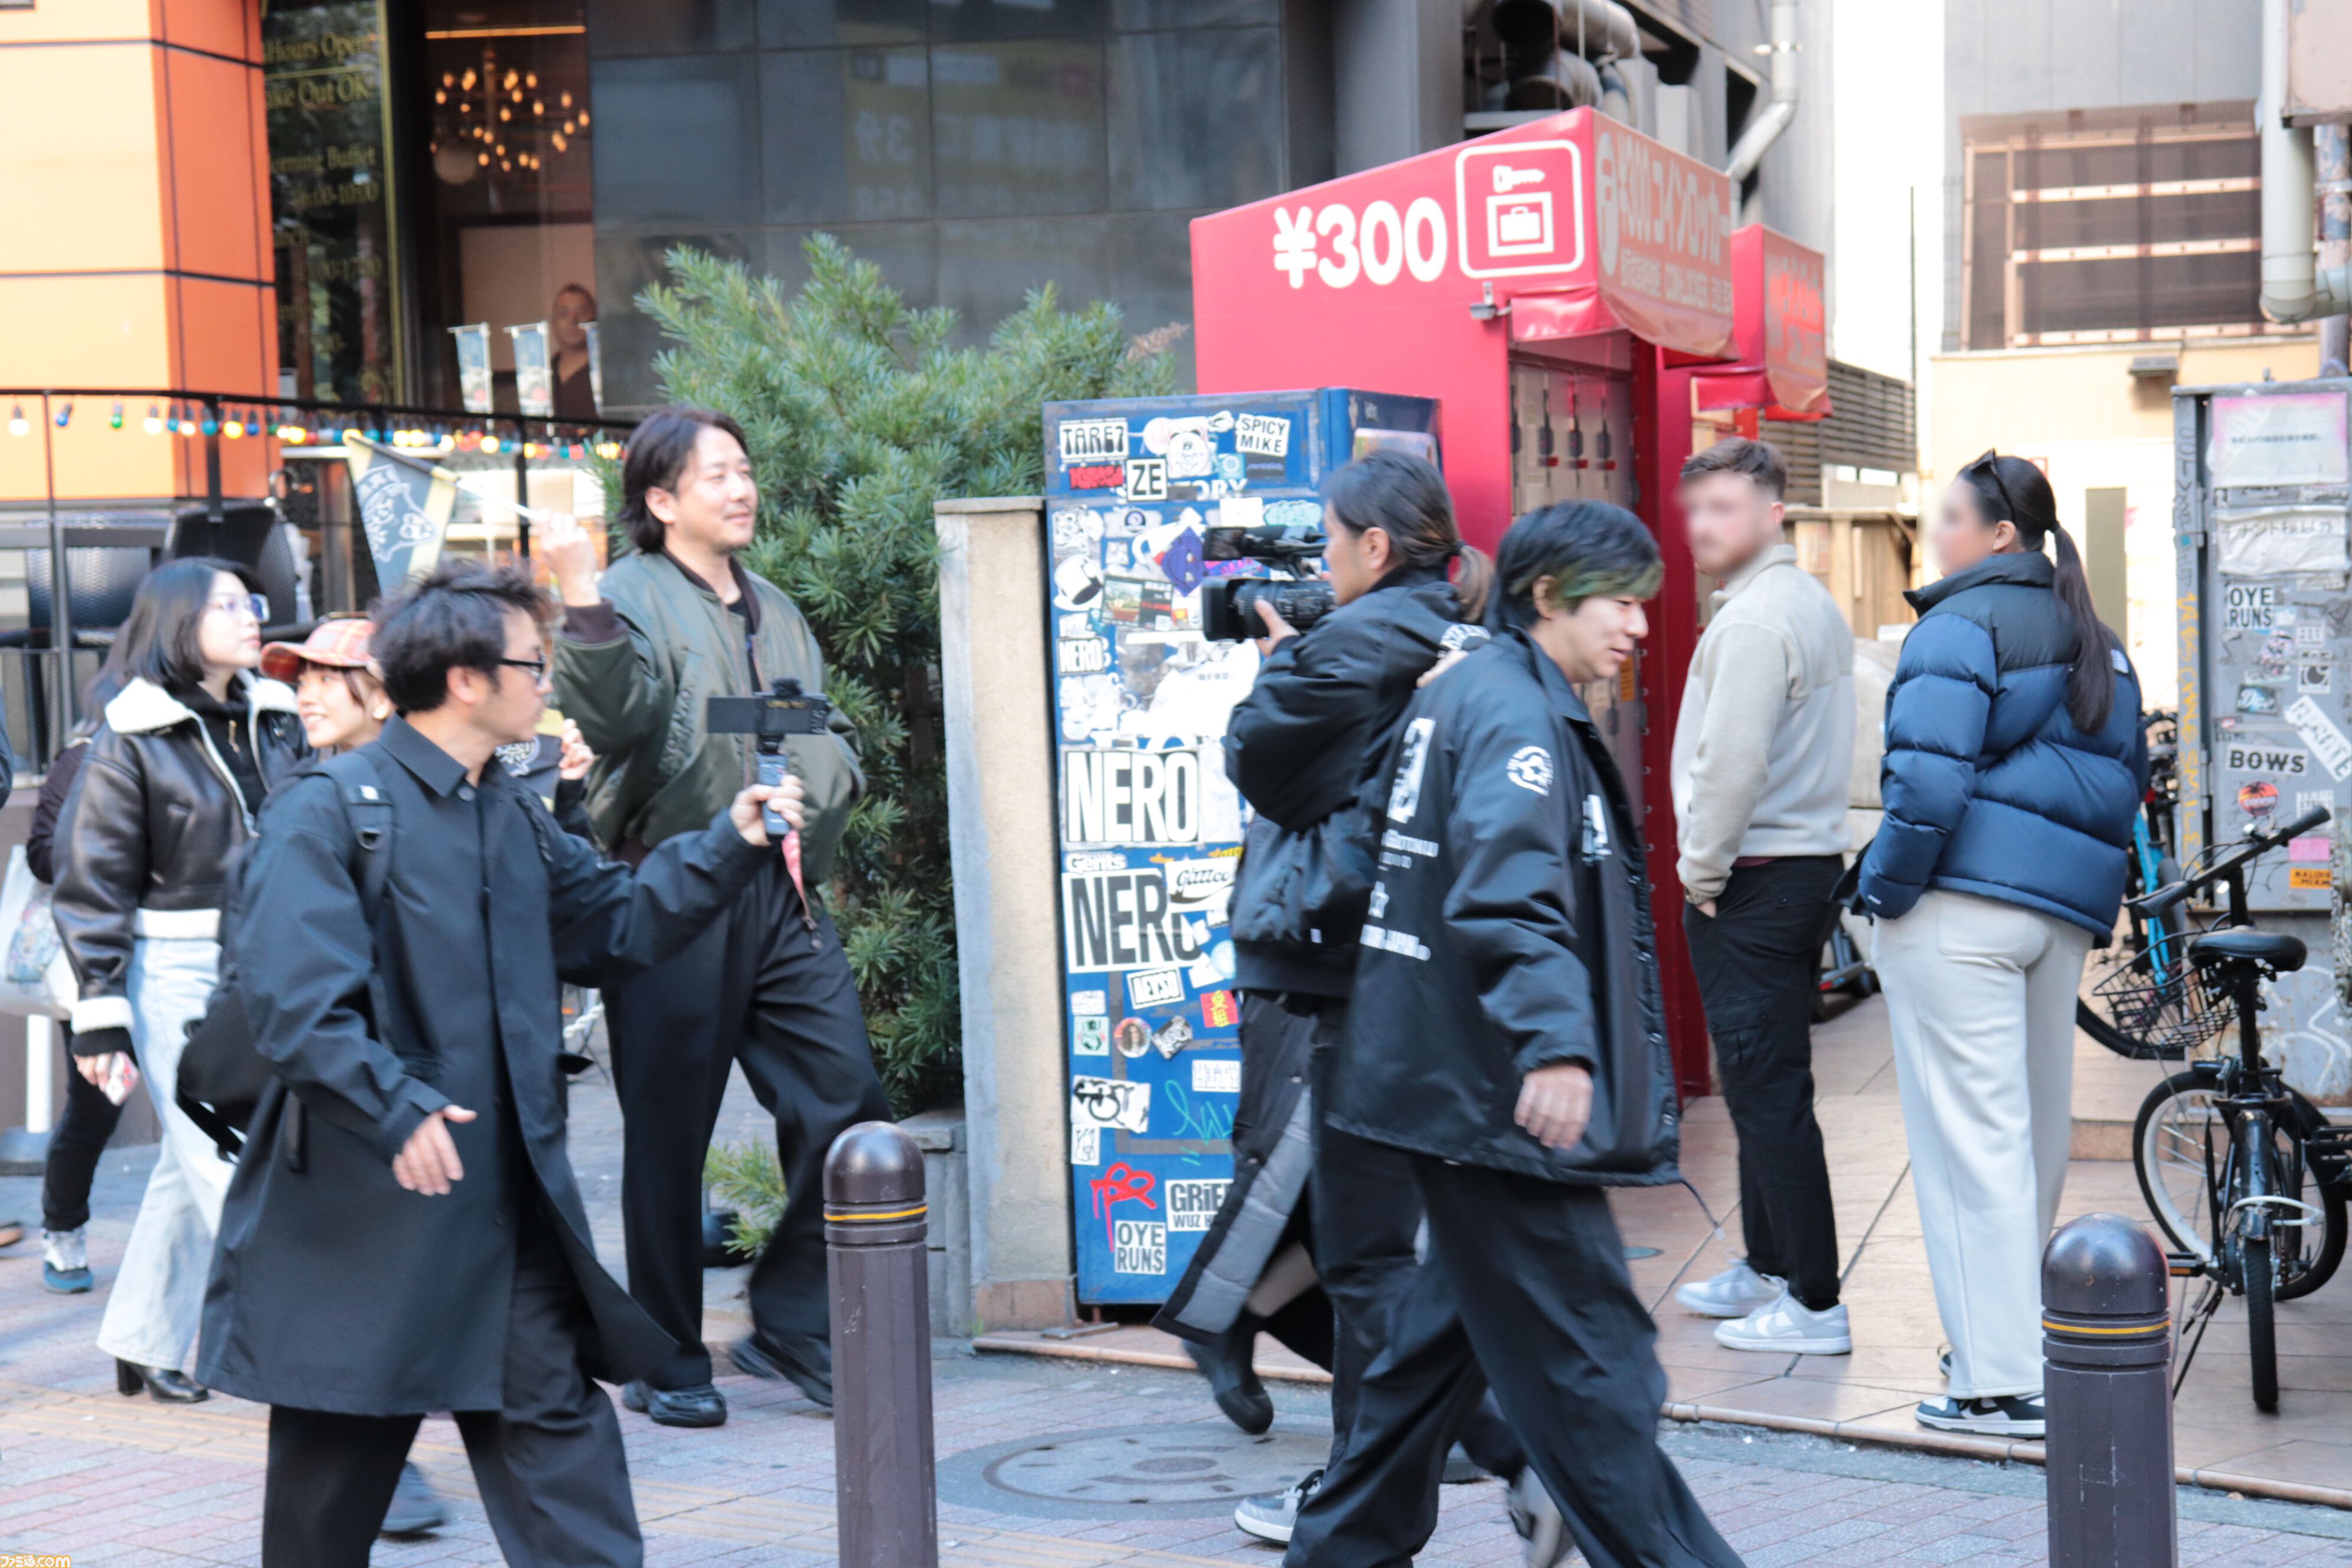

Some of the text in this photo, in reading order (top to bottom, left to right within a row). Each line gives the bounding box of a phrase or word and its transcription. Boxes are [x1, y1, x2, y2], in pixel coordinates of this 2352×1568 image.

[1272, 196, 1448, 289] ¥300
[1241, 417, 1287, 437] SPICY
[1239, 435, 1283, 453] MIKE
[1132, 463, 1162, 496] ZE
[2230, 587, 2272, 606] OYE
[2230, 609, 2273, 628] RUNS
[1059, 639, 1103, 673] NERO
[2229, 749, 2305, 773] BOWS
[1067, 751, 1199, 844] NERO
[1170, 1182, 1233, 1213] GRiE
[1173, 1214, 1217, 1229] WUZ H
[1118, 1223, 1164, 1246] OYE
[1117, 1249, 1164, 1272] RUNS
